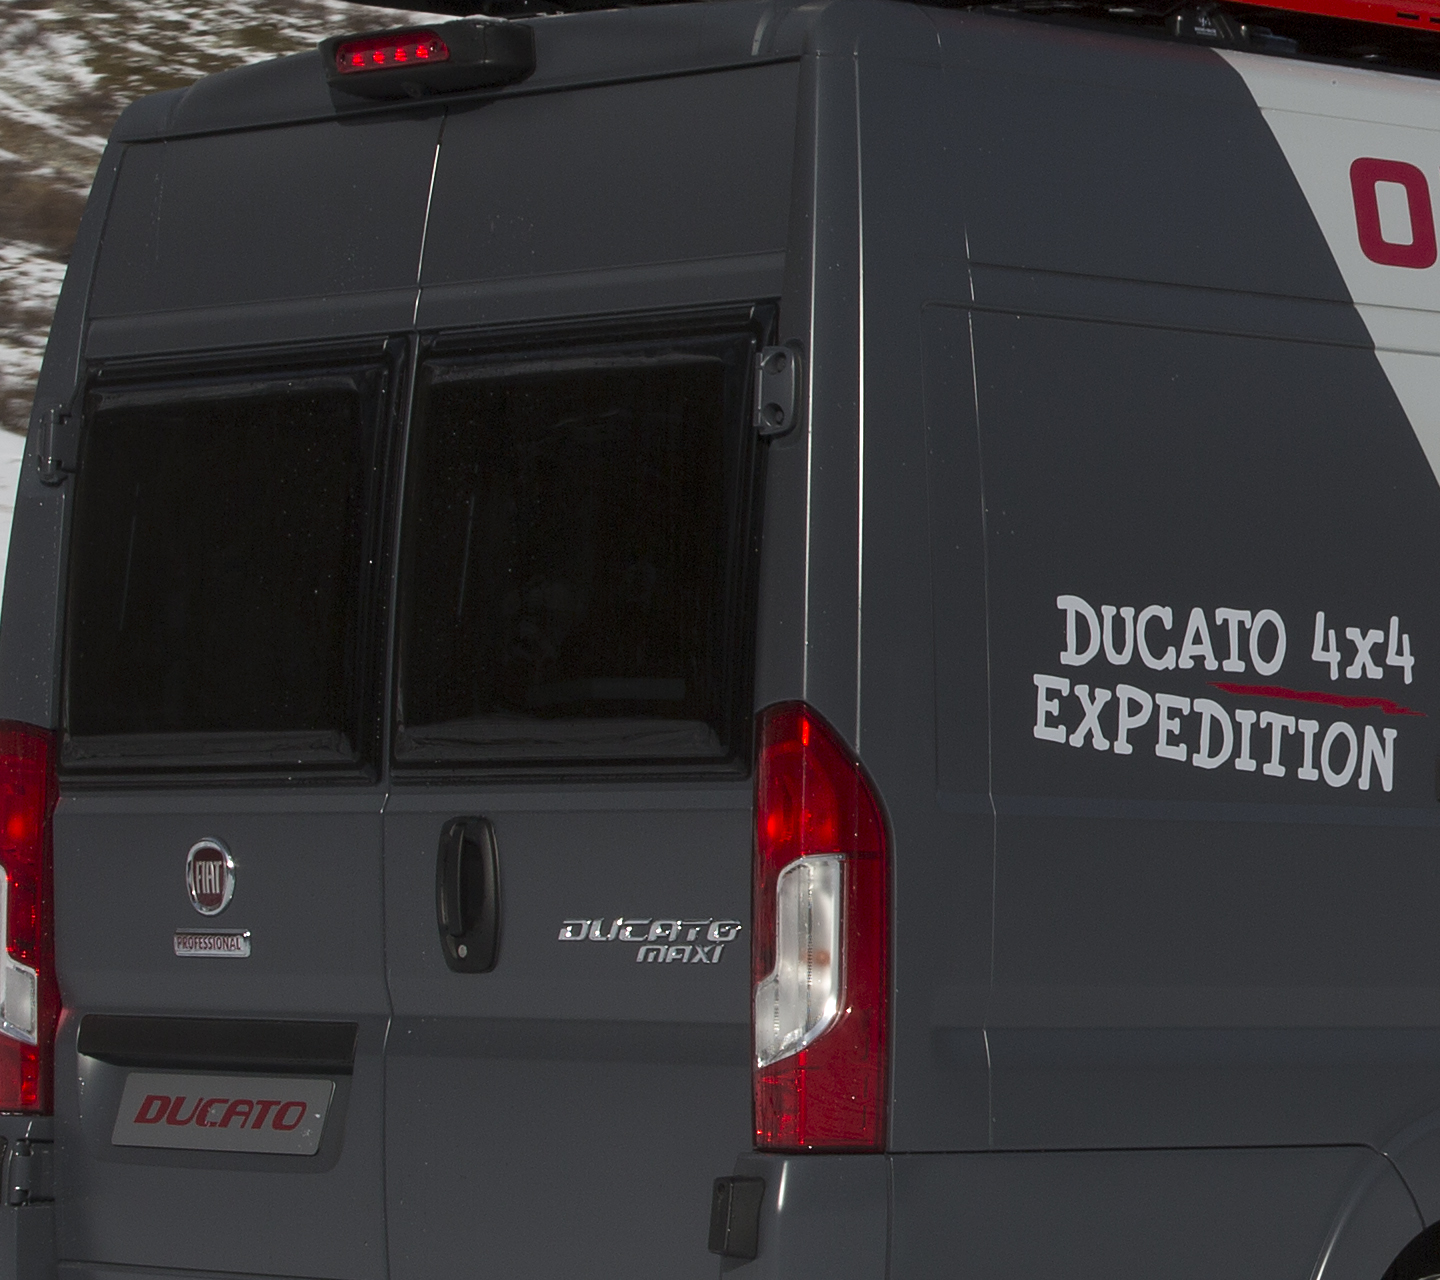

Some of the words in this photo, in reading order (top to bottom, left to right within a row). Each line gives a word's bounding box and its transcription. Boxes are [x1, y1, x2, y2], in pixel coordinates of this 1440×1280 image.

[1056, 594, 1287, 676] DUCATO
[1311, 610, 1415, 685] 4x4
[1033, 673, 1398, 793] EXPEDITION
[195, 860, 222, 894] FIAT
[176, 934, 242, 951] PROFESSIONAL
[558, 917, 741, 942] DUCATO
[636, 944, 724, 963] MAXI
[133, 1094, 307, 1131] DUCATO
